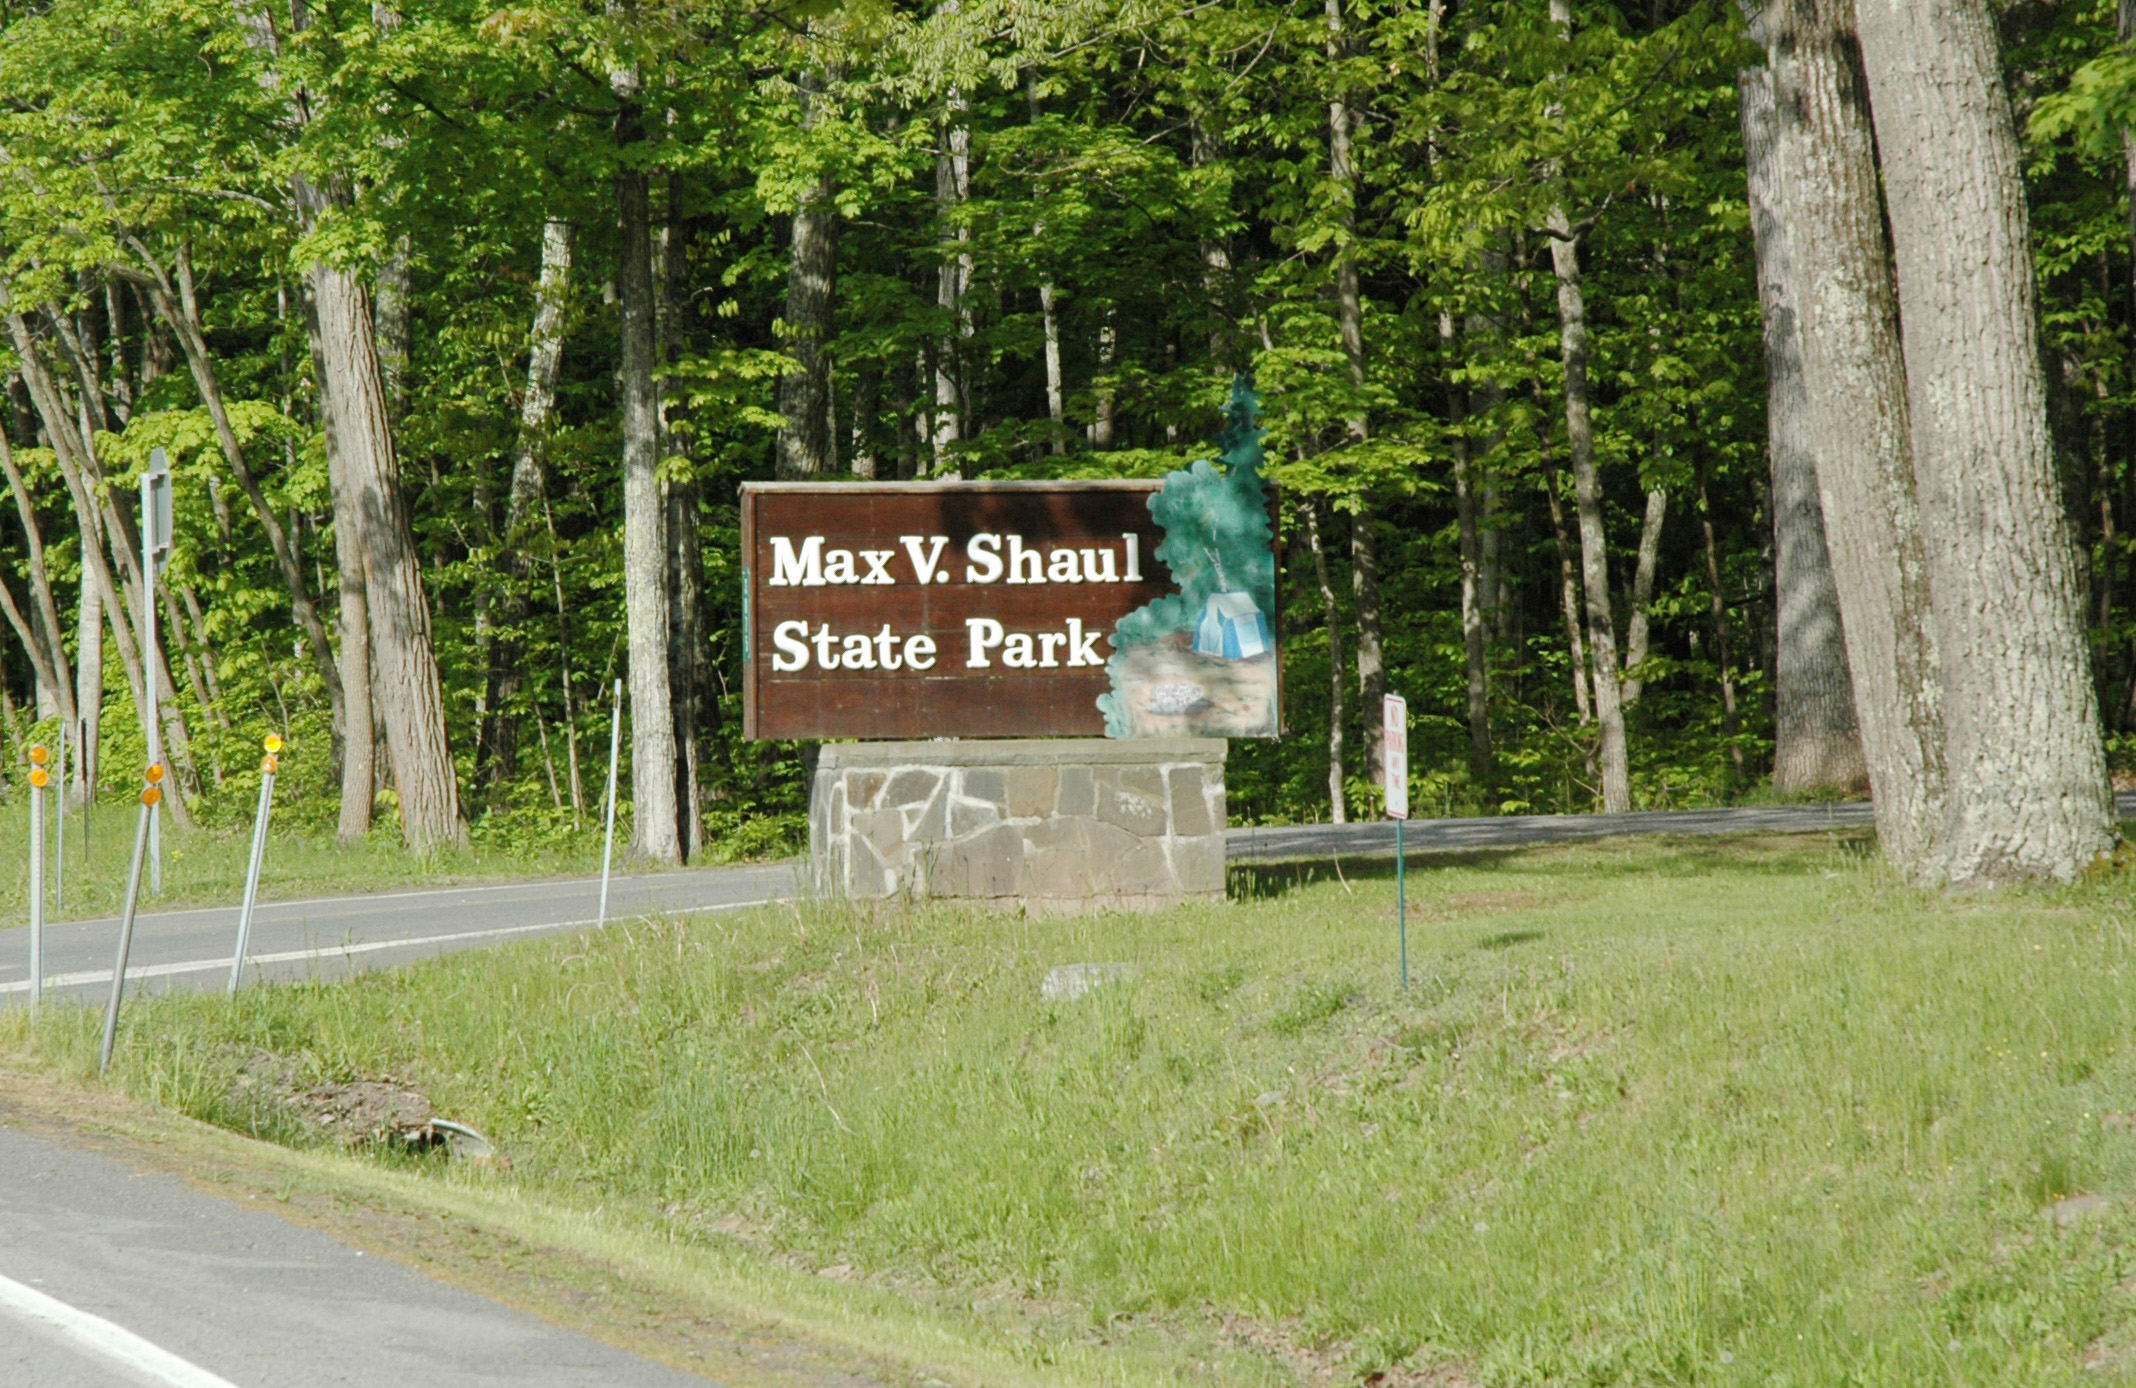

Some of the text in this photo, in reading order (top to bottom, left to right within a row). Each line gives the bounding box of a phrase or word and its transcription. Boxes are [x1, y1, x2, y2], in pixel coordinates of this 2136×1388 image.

[769, 532, 1144, 586] Max V. Shaul
[772, 617, 1104, 672] State Park
